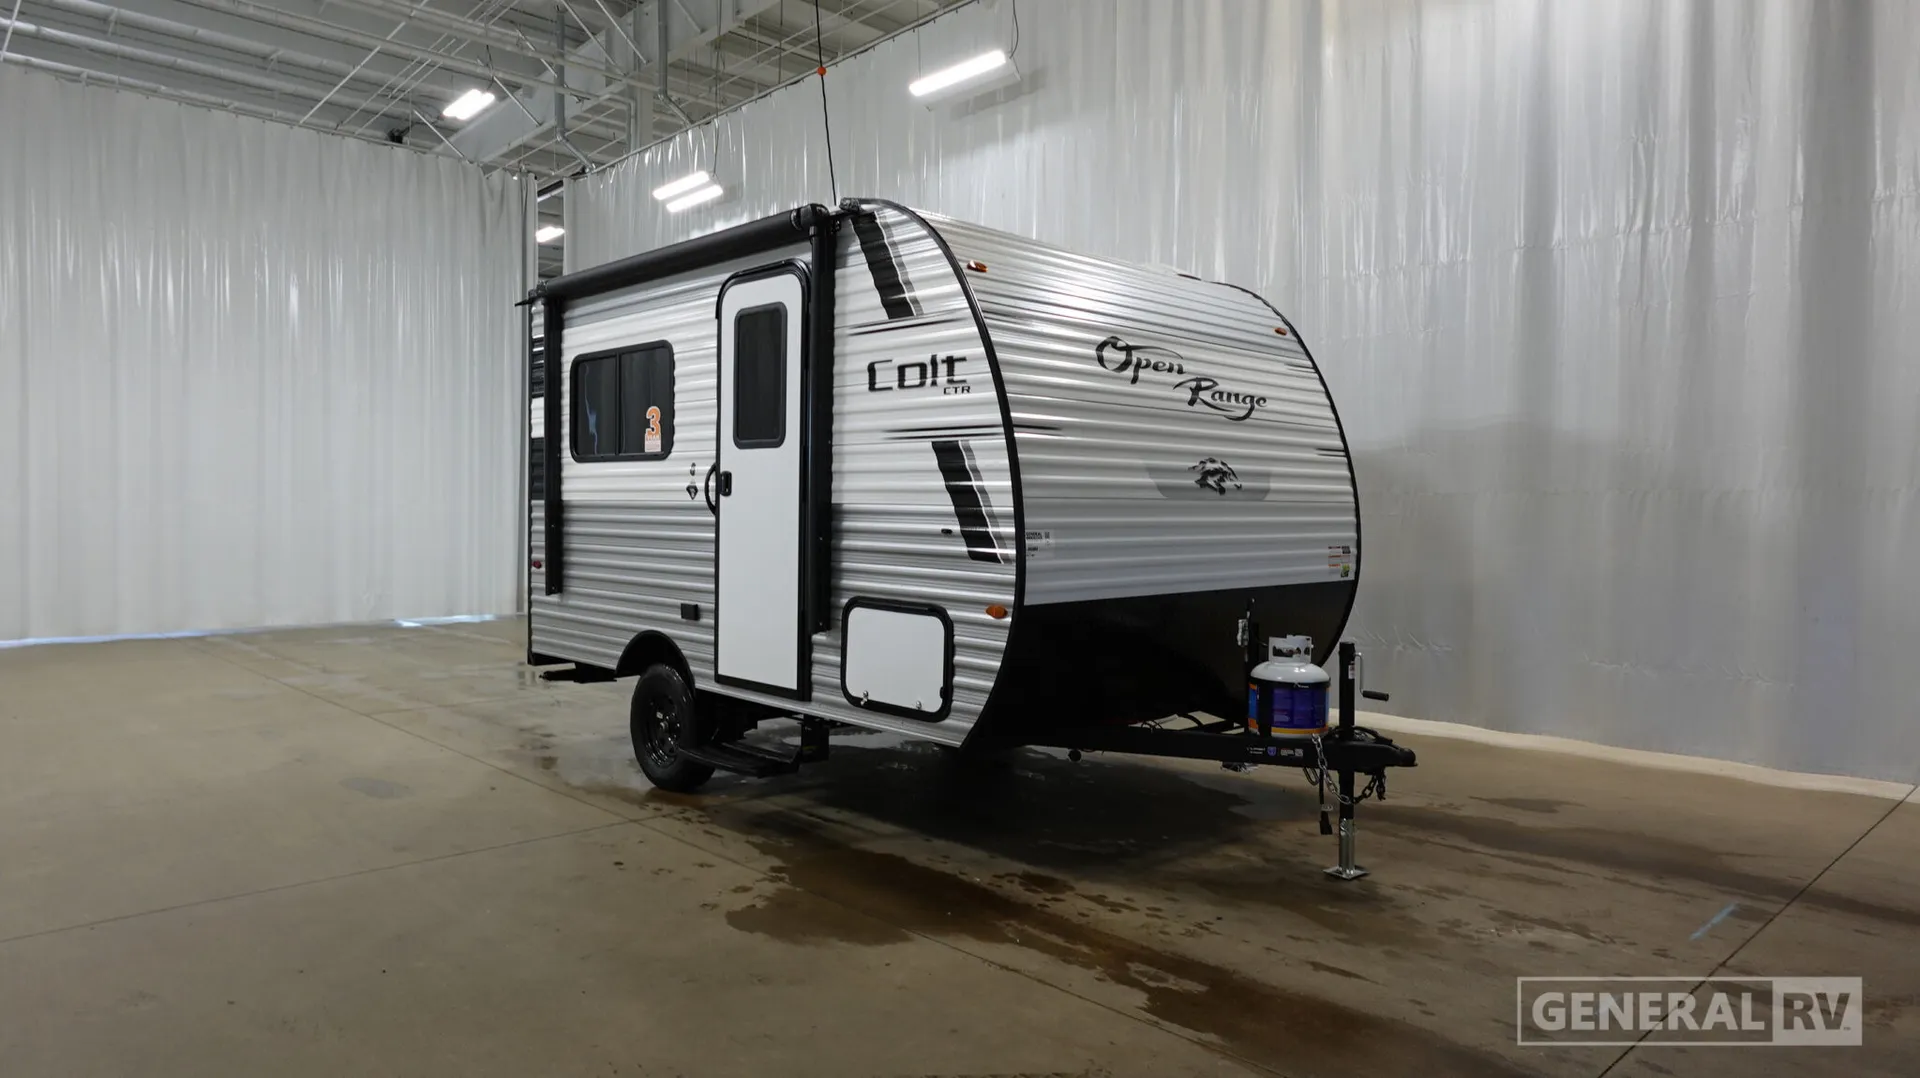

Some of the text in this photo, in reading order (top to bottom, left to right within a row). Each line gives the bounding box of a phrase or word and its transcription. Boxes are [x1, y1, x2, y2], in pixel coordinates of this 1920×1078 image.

[867, 354, 967, 392] Colt
[1096, 336, 1186, 384] Open
[943, 386, 971, 395] CTR
[1173, 377, 1267, 421] Range
[646, 406, 661, 436] 3
